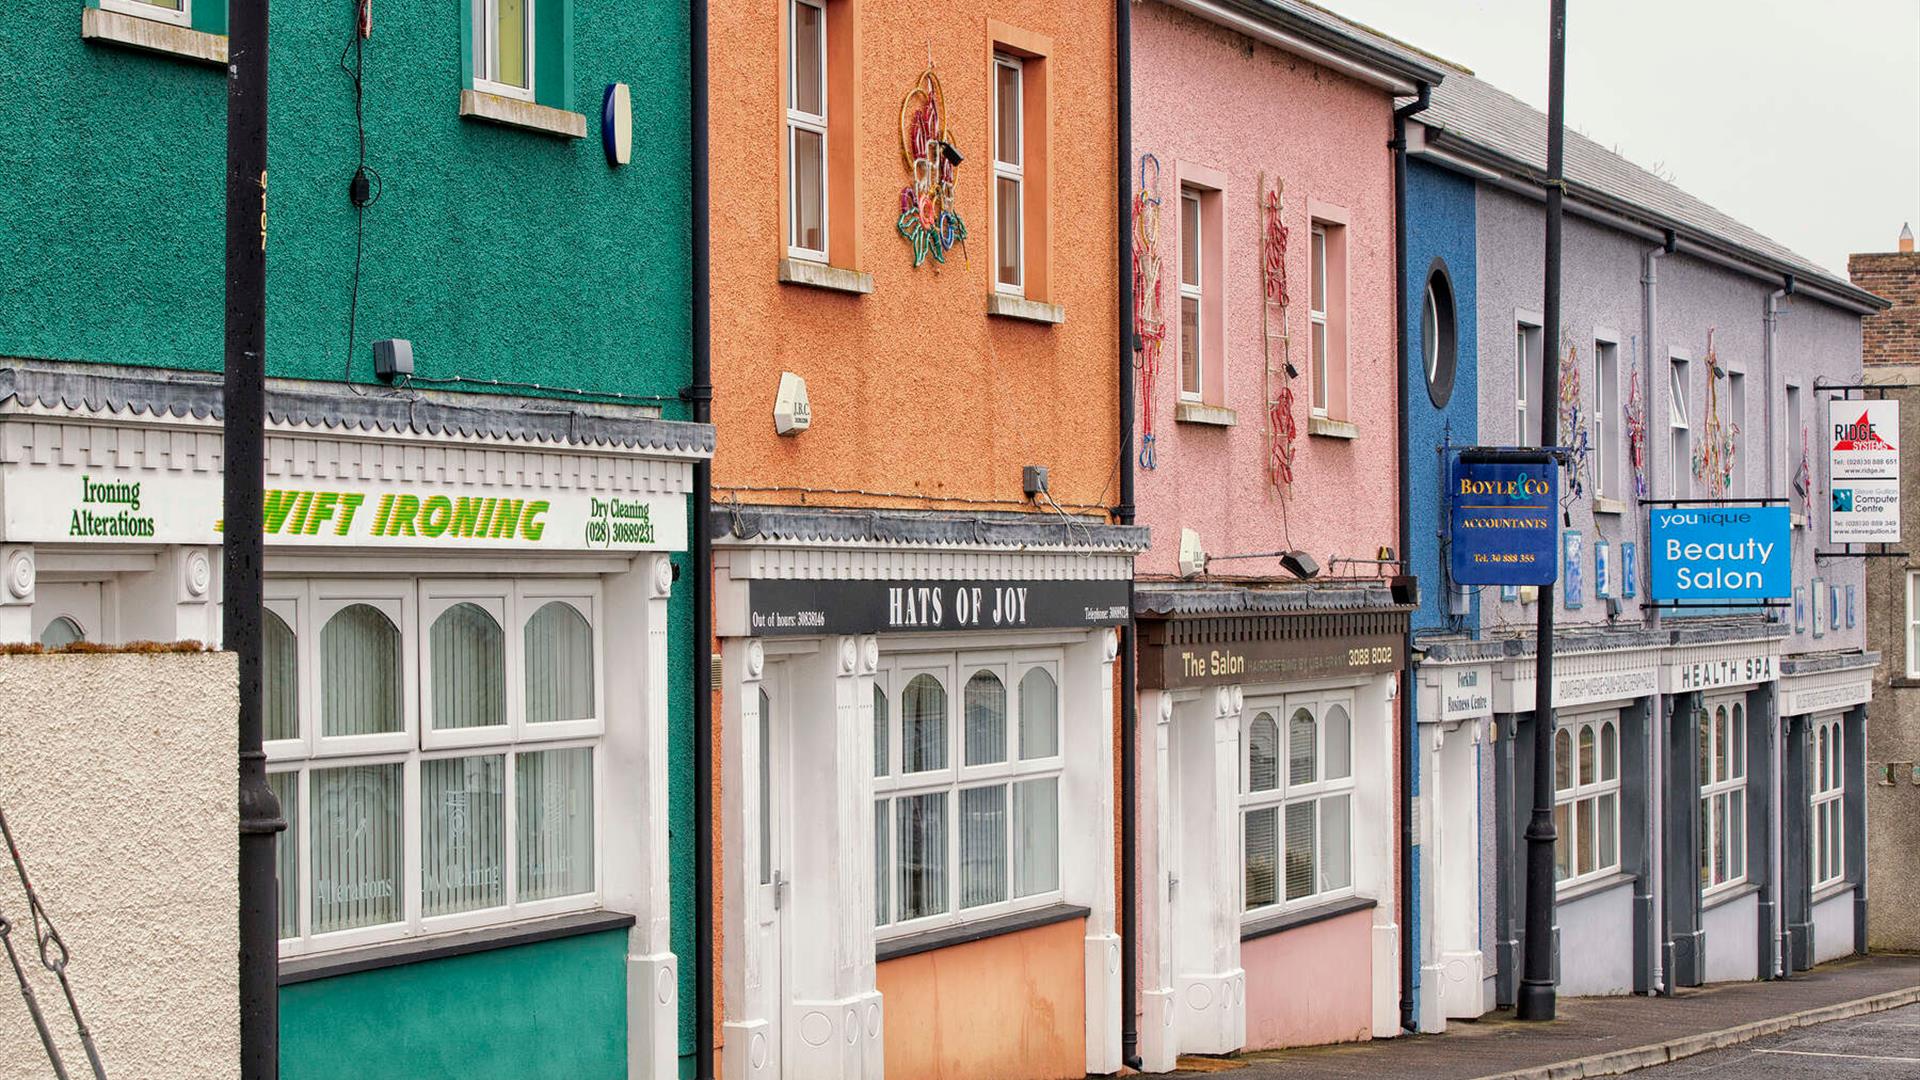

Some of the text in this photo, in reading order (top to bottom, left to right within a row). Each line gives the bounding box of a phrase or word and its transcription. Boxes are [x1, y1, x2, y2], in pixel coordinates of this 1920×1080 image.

[1835, 424, 1876, 441] RIDGE
[1852, 441, 1888, 451] SYSTEMS
[82, 475, 140, 510] Ironing
[1855, 495, 1897, 504] Computer
[213, 489, 550, 541] WIFT IRONING
[591, 496, 650, 525] Dry Cleaning
[1660, 511, 1751, 528] younique
[1855, 504, 1884, 513] Centre
[69, 510, 155, 537] Alterations
[585, 522, 656, 548] (028) 30889231
[1461, 518, 1548, 530] ACCOUNTANTS
[1666, 538, 1774, 564] Beauty
[1676, 567, 1763, 590] Salon
[888, 586, 1028, 627] HATS OF JOY
[752, 611, 766, 628] Out
[767, 612, 775, 627] of
[1182, 650, 1245, 677] The Salon
[1348, 646, 1393, 667] 3088 8002
[1682, 661, 1738, 689] HEALTH
[1745, 656, 1771, 681] SPA
[1447, 694, 1487, 712] Business Centre
